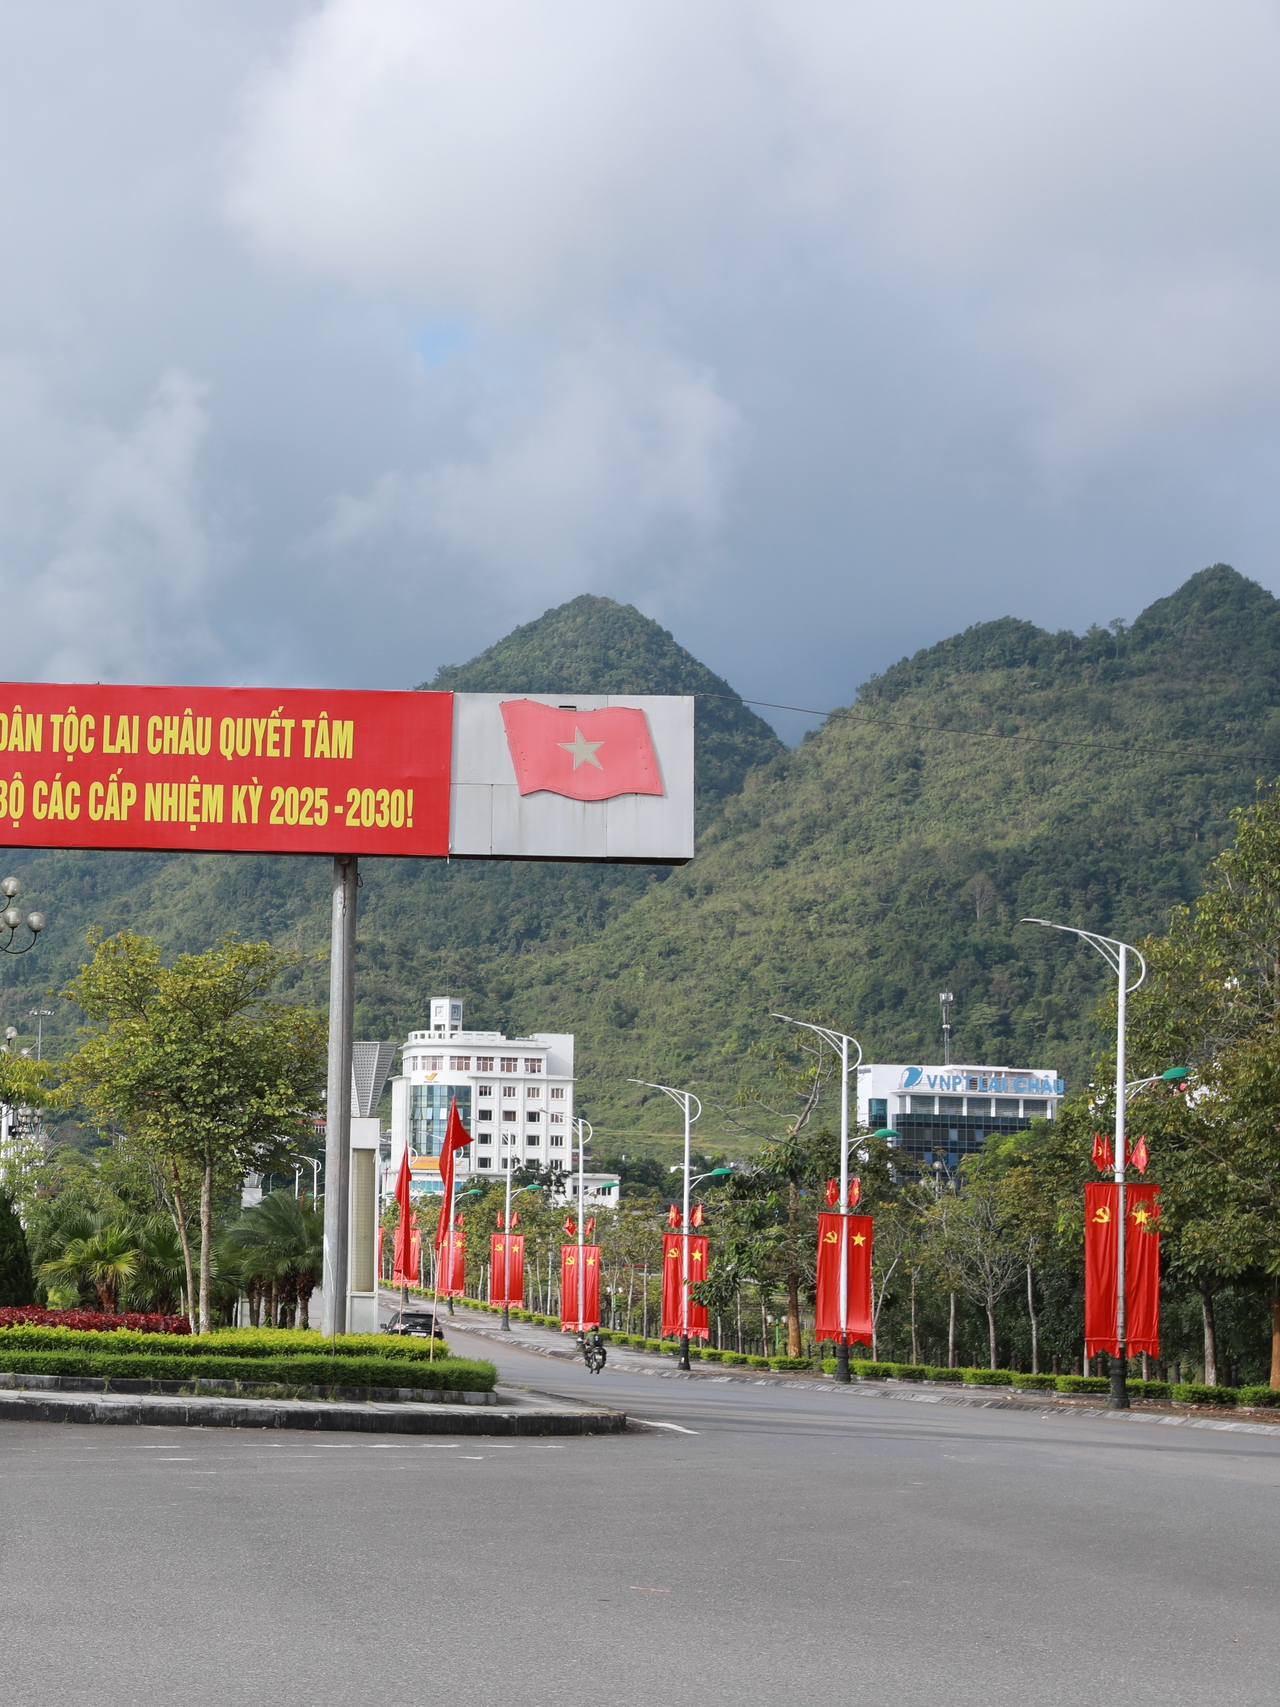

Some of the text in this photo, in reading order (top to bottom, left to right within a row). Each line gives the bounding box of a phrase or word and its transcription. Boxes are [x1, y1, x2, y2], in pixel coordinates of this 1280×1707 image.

[51, 706, 95, 761] TỘC
[103, 716, 139, 753] LAI
[148, 708, 212, 755] CHÂU
[220, 706, 295, 760] QUYẾT
[302, 712, 353, 758] TÂM
[33, 773, 80, 820] CÁC
[89, 768, 137, 820] CẤP
[145, 776, 224, 831] NHIỆM
[232, 777, 263, 823] KỲ
[927, 1074, 1065, 1094] VNPT LAI CHÂU
